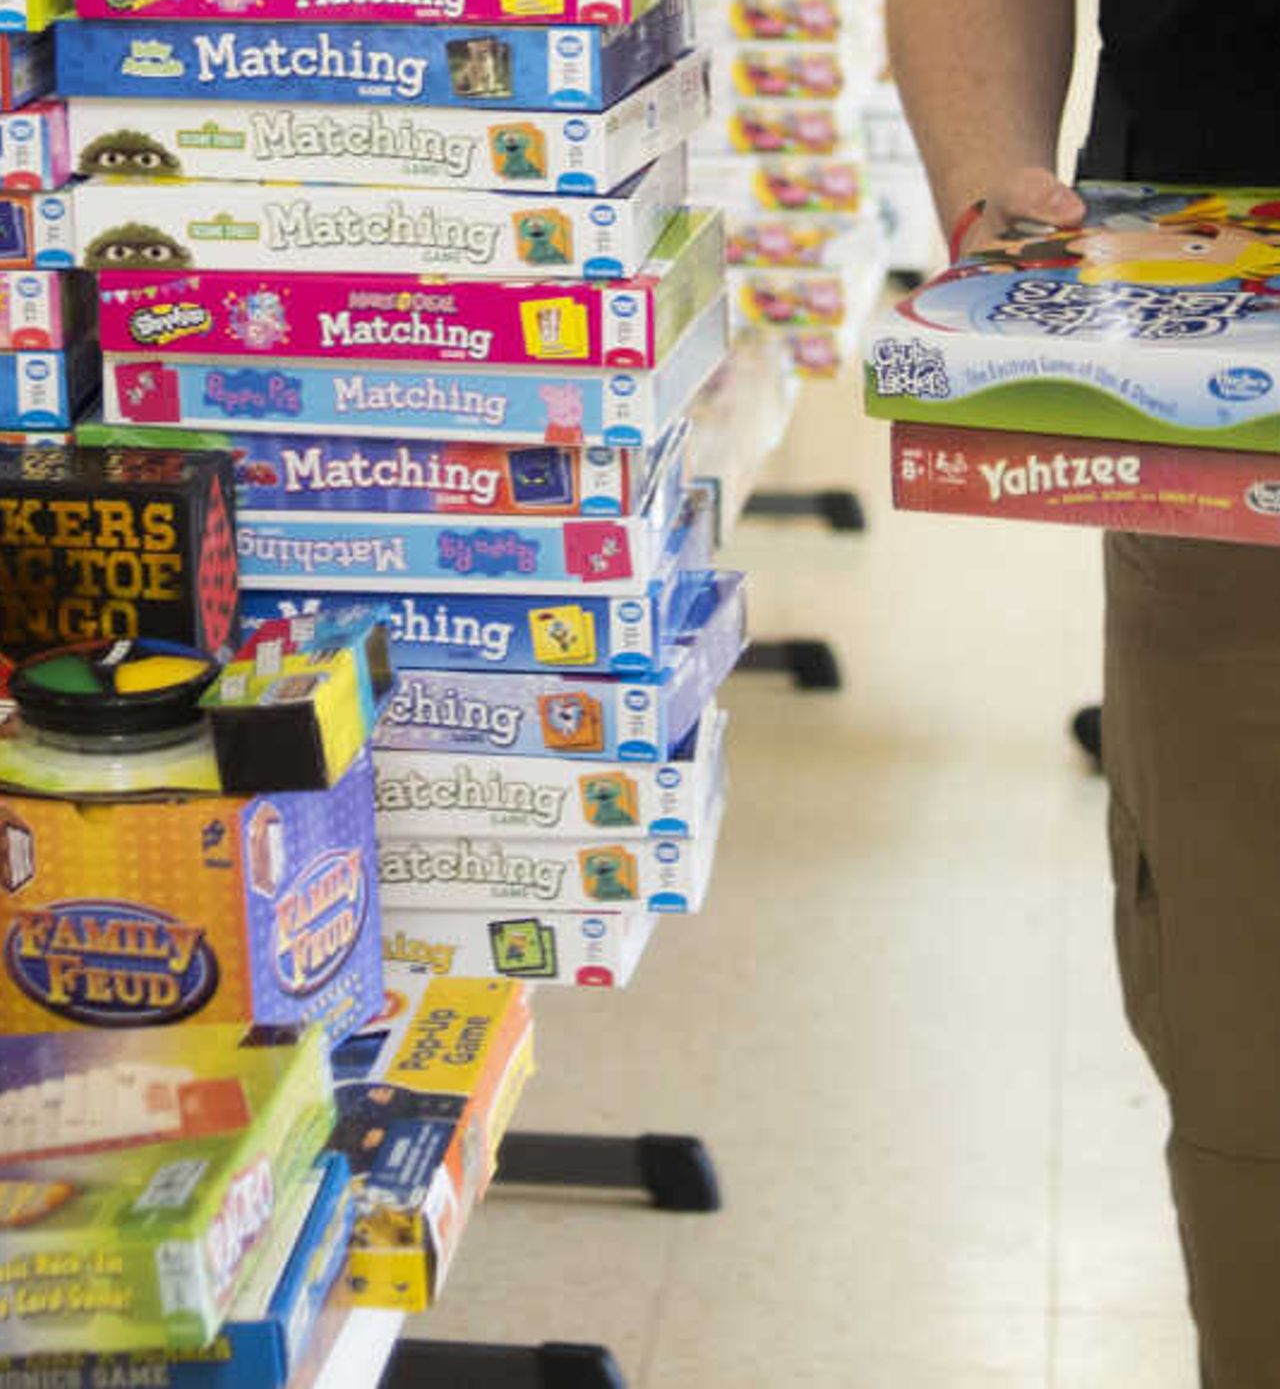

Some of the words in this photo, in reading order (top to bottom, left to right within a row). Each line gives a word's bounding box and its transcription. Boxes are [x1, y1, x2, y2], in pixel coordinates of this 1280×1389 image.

[194, 32, 428, 97] Matching
[250, 111, 478, 175] Matching
[263, 201, 502, 265] Matching
[319, 313, 494, 358] Matching
[333, 376, 508, 424] Matching
[282, 448, 502, 506] Matching
[980, 454, 1142, 501] Yahtzee
[66, 550, 183, 601] TOE
[388, 682, 522, 745] ching
[276, 849, 362, 942] FAMILY
[17, 909, 206, 970] FAMILY
[291, 905, 356, 984] FEUD
[45, 954, 183, 1008] FEUD
[396, 1007, 460, 1071] Pop-Up
[442, 1014, 493, 1065] Game
[16, 1289, 62, 1315] Card
